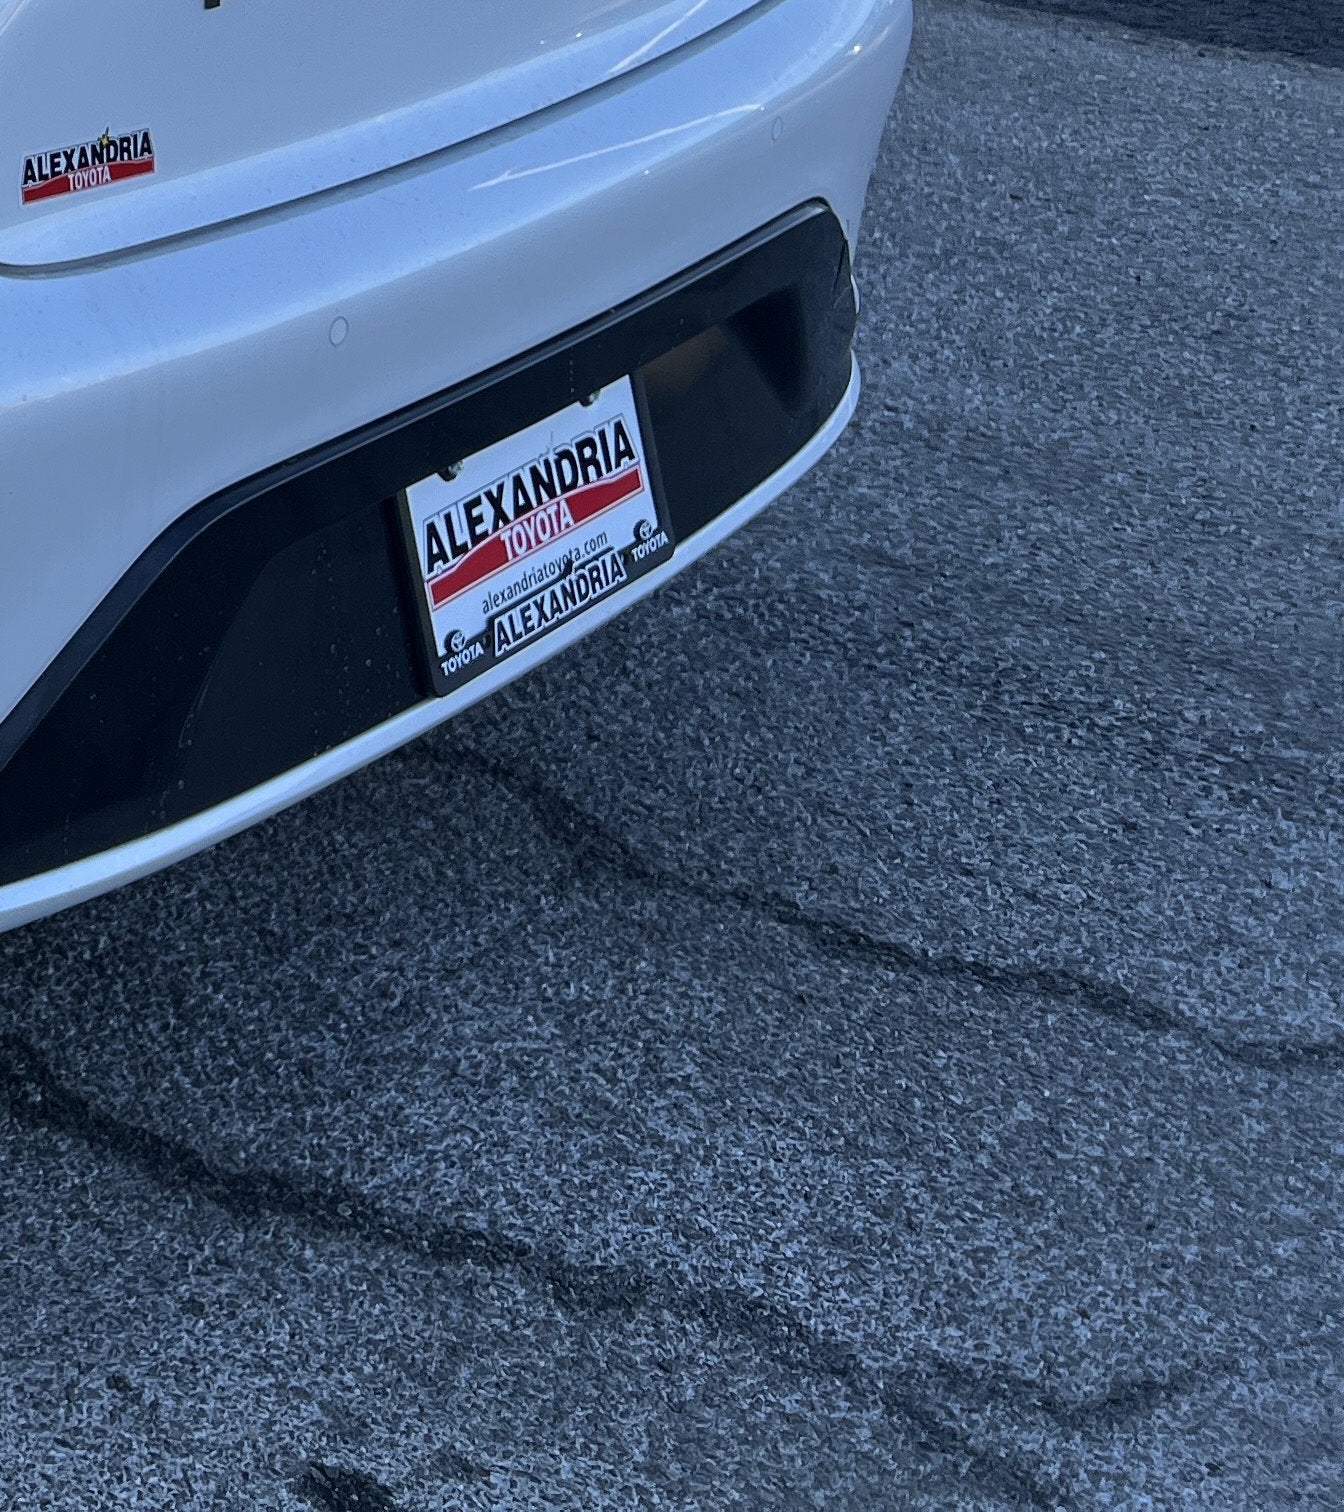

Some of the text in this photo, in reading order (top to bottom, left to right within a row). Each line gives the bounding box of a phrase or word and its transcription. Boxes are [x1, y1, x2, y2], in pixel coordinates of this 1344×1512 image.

[23, 130, 153, 186] ALEXANDRIA
[68, 165, 112, 192] TOYOTA
[424, 419, 638, 576] ALEXANDRIA
[500, 498, 575, 562] TOYOTA
[630, 531, 670, 562] TOYOTA
[494, 555, 627, 657] ALEXANDRIA
[441, 641, 485, 676] TOYOTA
